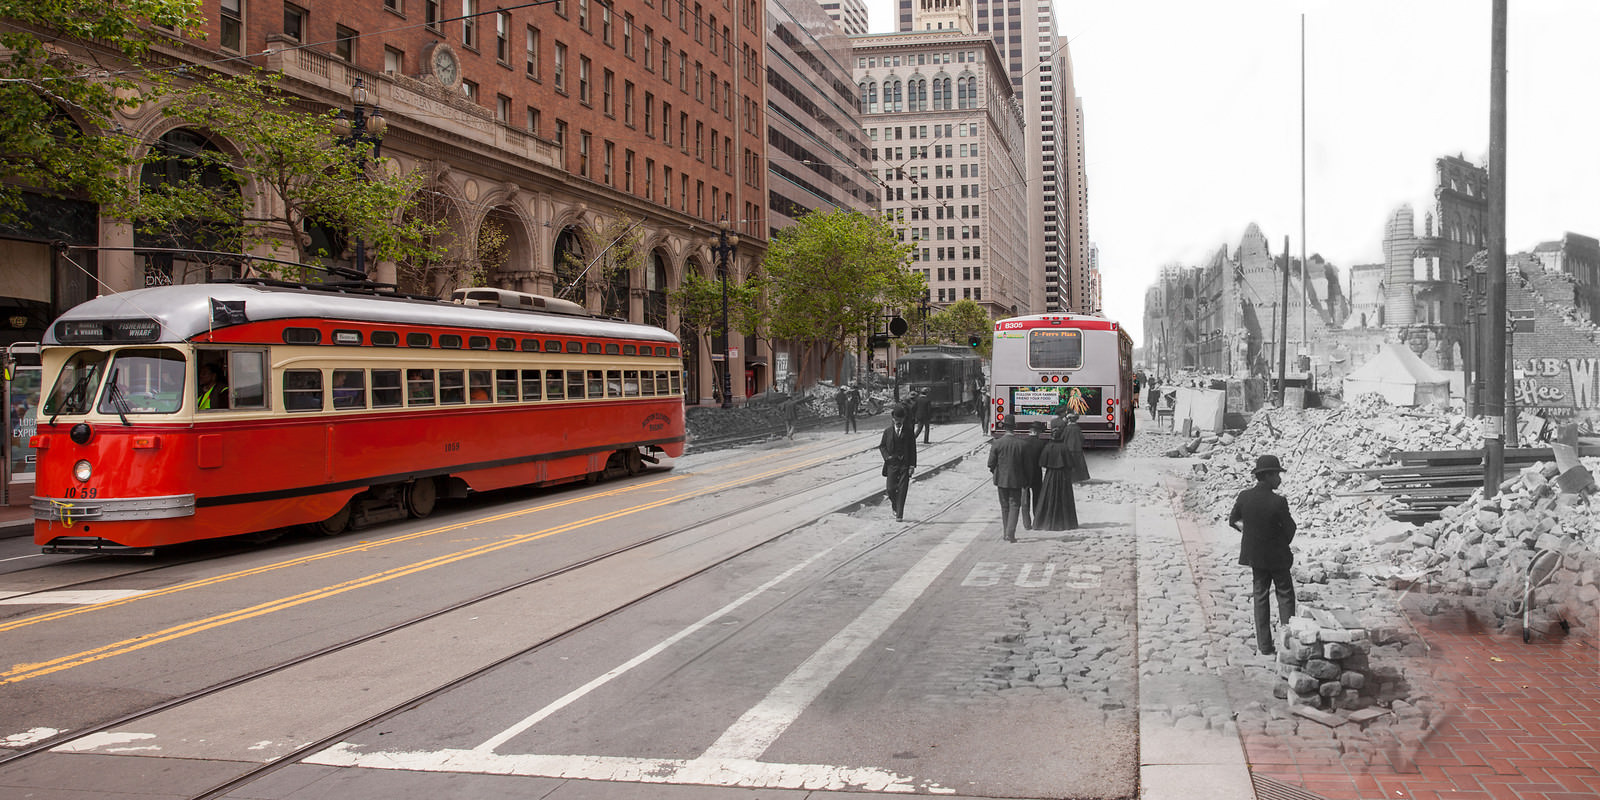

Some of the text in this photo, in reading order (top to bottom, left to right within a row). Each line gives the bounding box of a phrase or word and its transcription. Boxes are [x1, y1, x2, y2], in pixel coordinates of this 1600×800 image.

[65, 323, 70, 336] F
[1514, 379, 1566, 404] offee
[445, 442, 459, 452] 1059
[960, 561, 1102, 588] BUS
